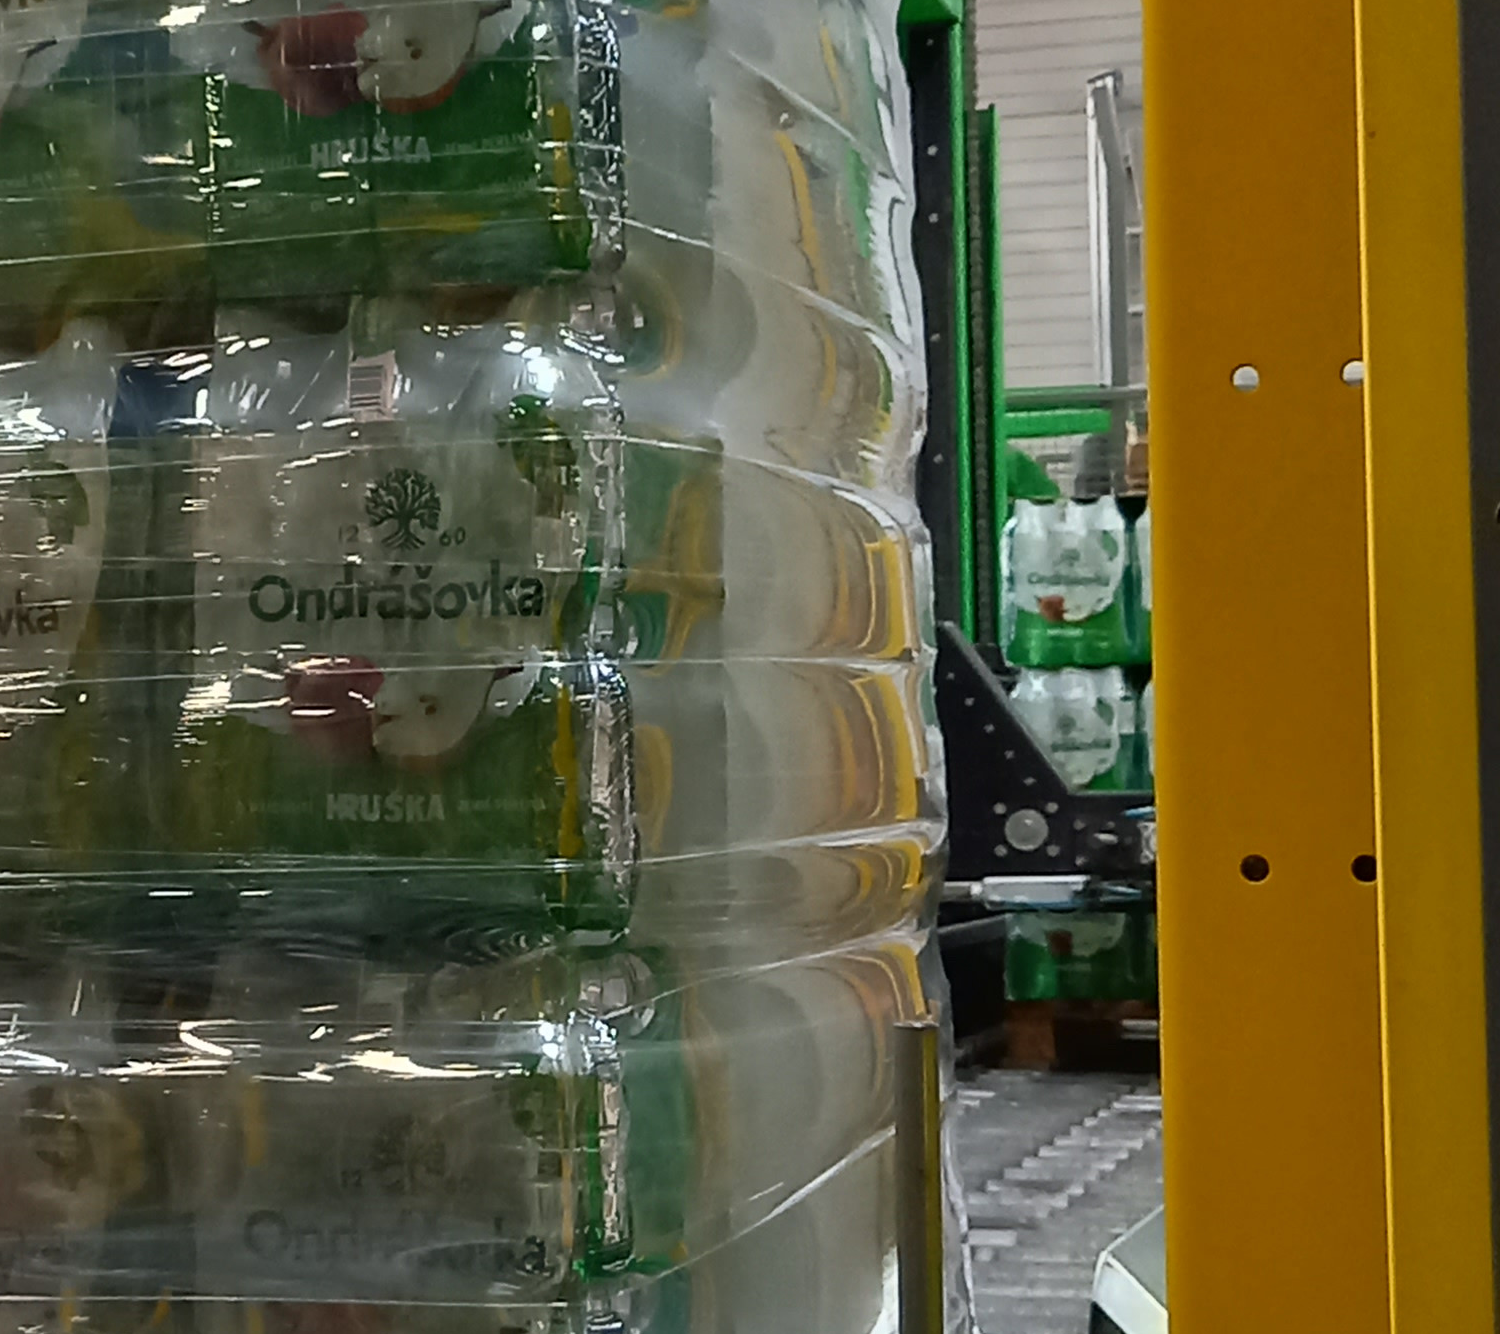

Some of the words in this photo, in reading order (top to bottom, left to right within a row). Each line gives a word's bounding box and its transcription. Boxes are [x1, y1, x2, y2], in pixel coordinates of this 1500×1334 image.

[338, 524, 360, 544] 12
[438, 525, 467, 547] 60
[248, 559, 545, 623] Ondrášovka
[326, 790, 446, 823] HRUŠKA
